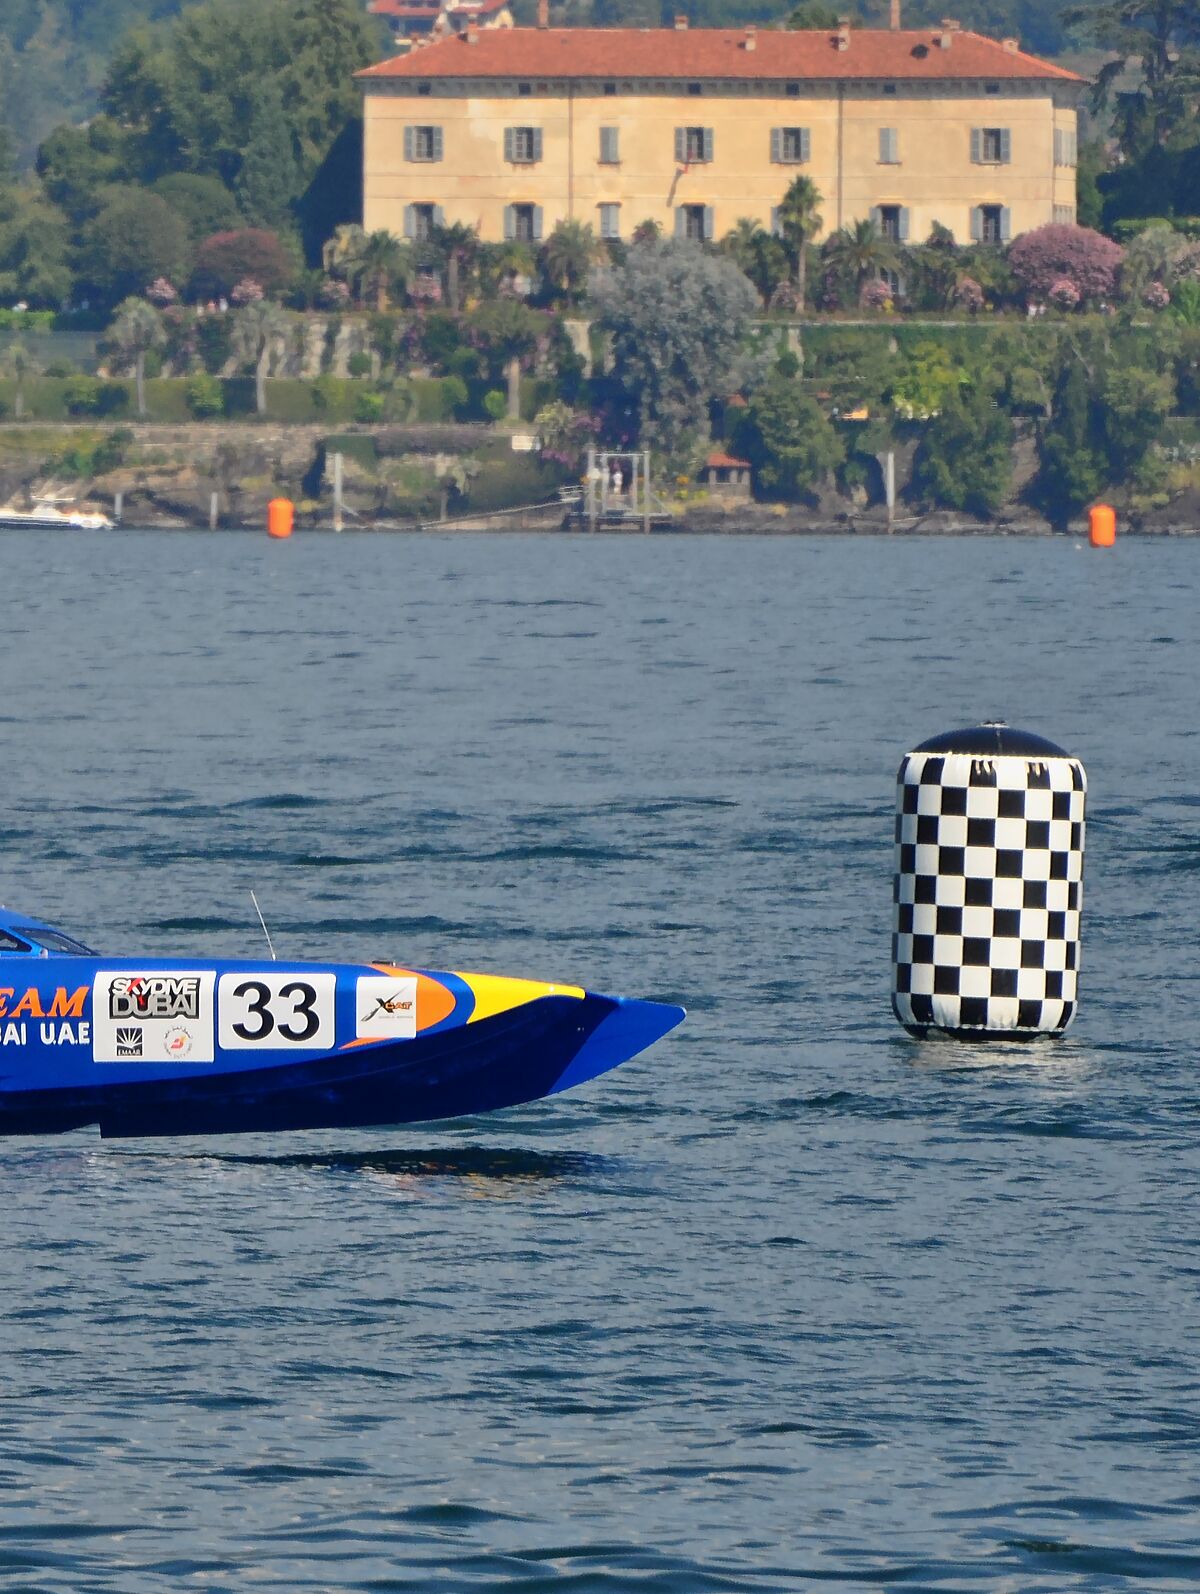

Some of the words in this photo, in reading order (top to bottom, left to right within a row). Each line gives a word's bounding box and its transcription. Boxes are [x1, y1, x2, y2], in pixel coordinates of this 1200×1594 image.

[111, 979, 198, 995] SKYDIVE
[112, 993, 197, 1016] DUBAI
[232, 981, 320, 1042] 33
